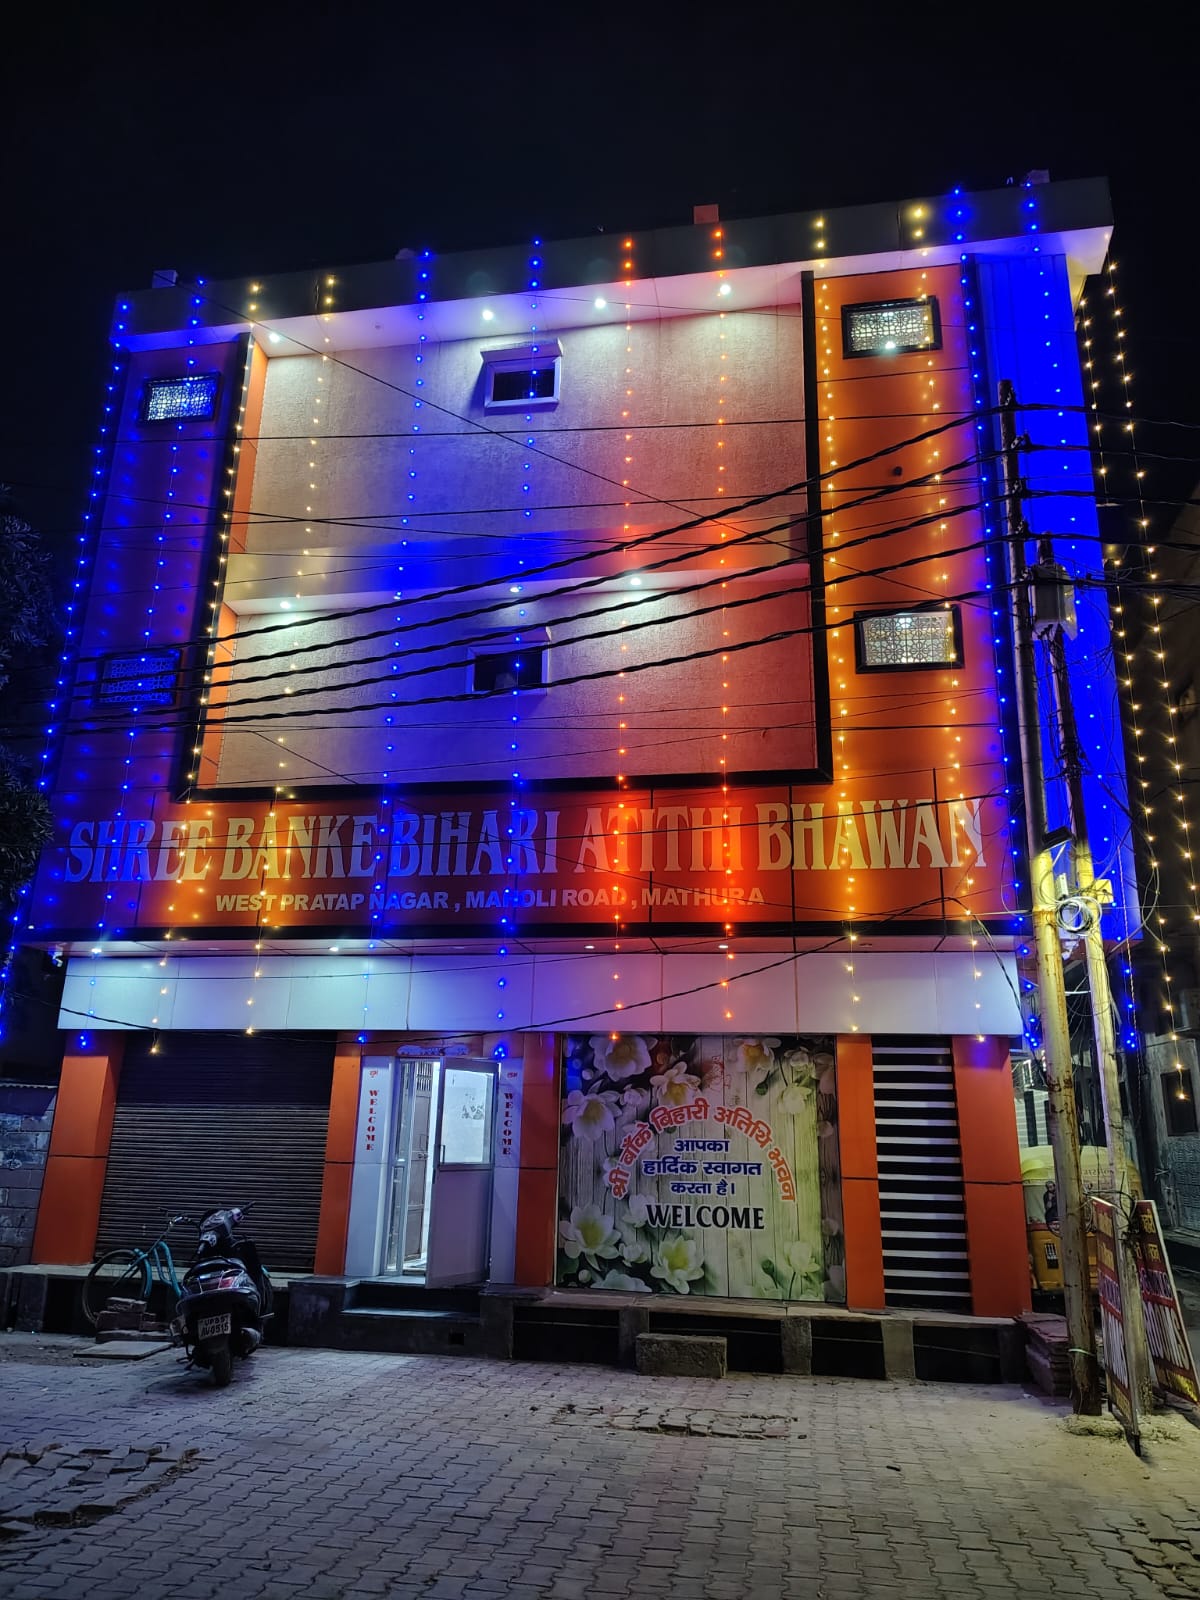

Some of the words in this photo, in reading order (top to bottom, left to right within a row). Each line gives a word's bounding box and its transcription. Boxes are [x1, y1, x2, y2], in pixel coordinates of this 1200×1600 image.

[64, 818, 213, 883] SHREE
[219, 814, 378, 880] BANKE
[387, 808, 560, 877] BIHARI
[574, 805, 744, 874] ATITHI
[755, 799, 986, 870] BHAWAN
[216, 895, 277, 911] WEST
[280, 893, 365, 912] PRATAP
[641, 887, 765, 906] MATHURA
[366, 1090, 378, 1151] WELCOME
[502, 1093, 514, 1155] WELCOME
[608, 1166, 630, 1198] श्री
[650, 1097, 709, 1131] बिहारी
[714, 1106, 772, 1148] अतिथि
[767, 1147, 796, 1202] भवन
[673, 1139, 730, 1152] आपका
[643, 1155, 698, 1174] हार्दिक
[703, 1161, 763, 1176] स्वागत
[670, 1181, 712, 1194] करता
[646, 1204, 765, 1230] WELCOME
